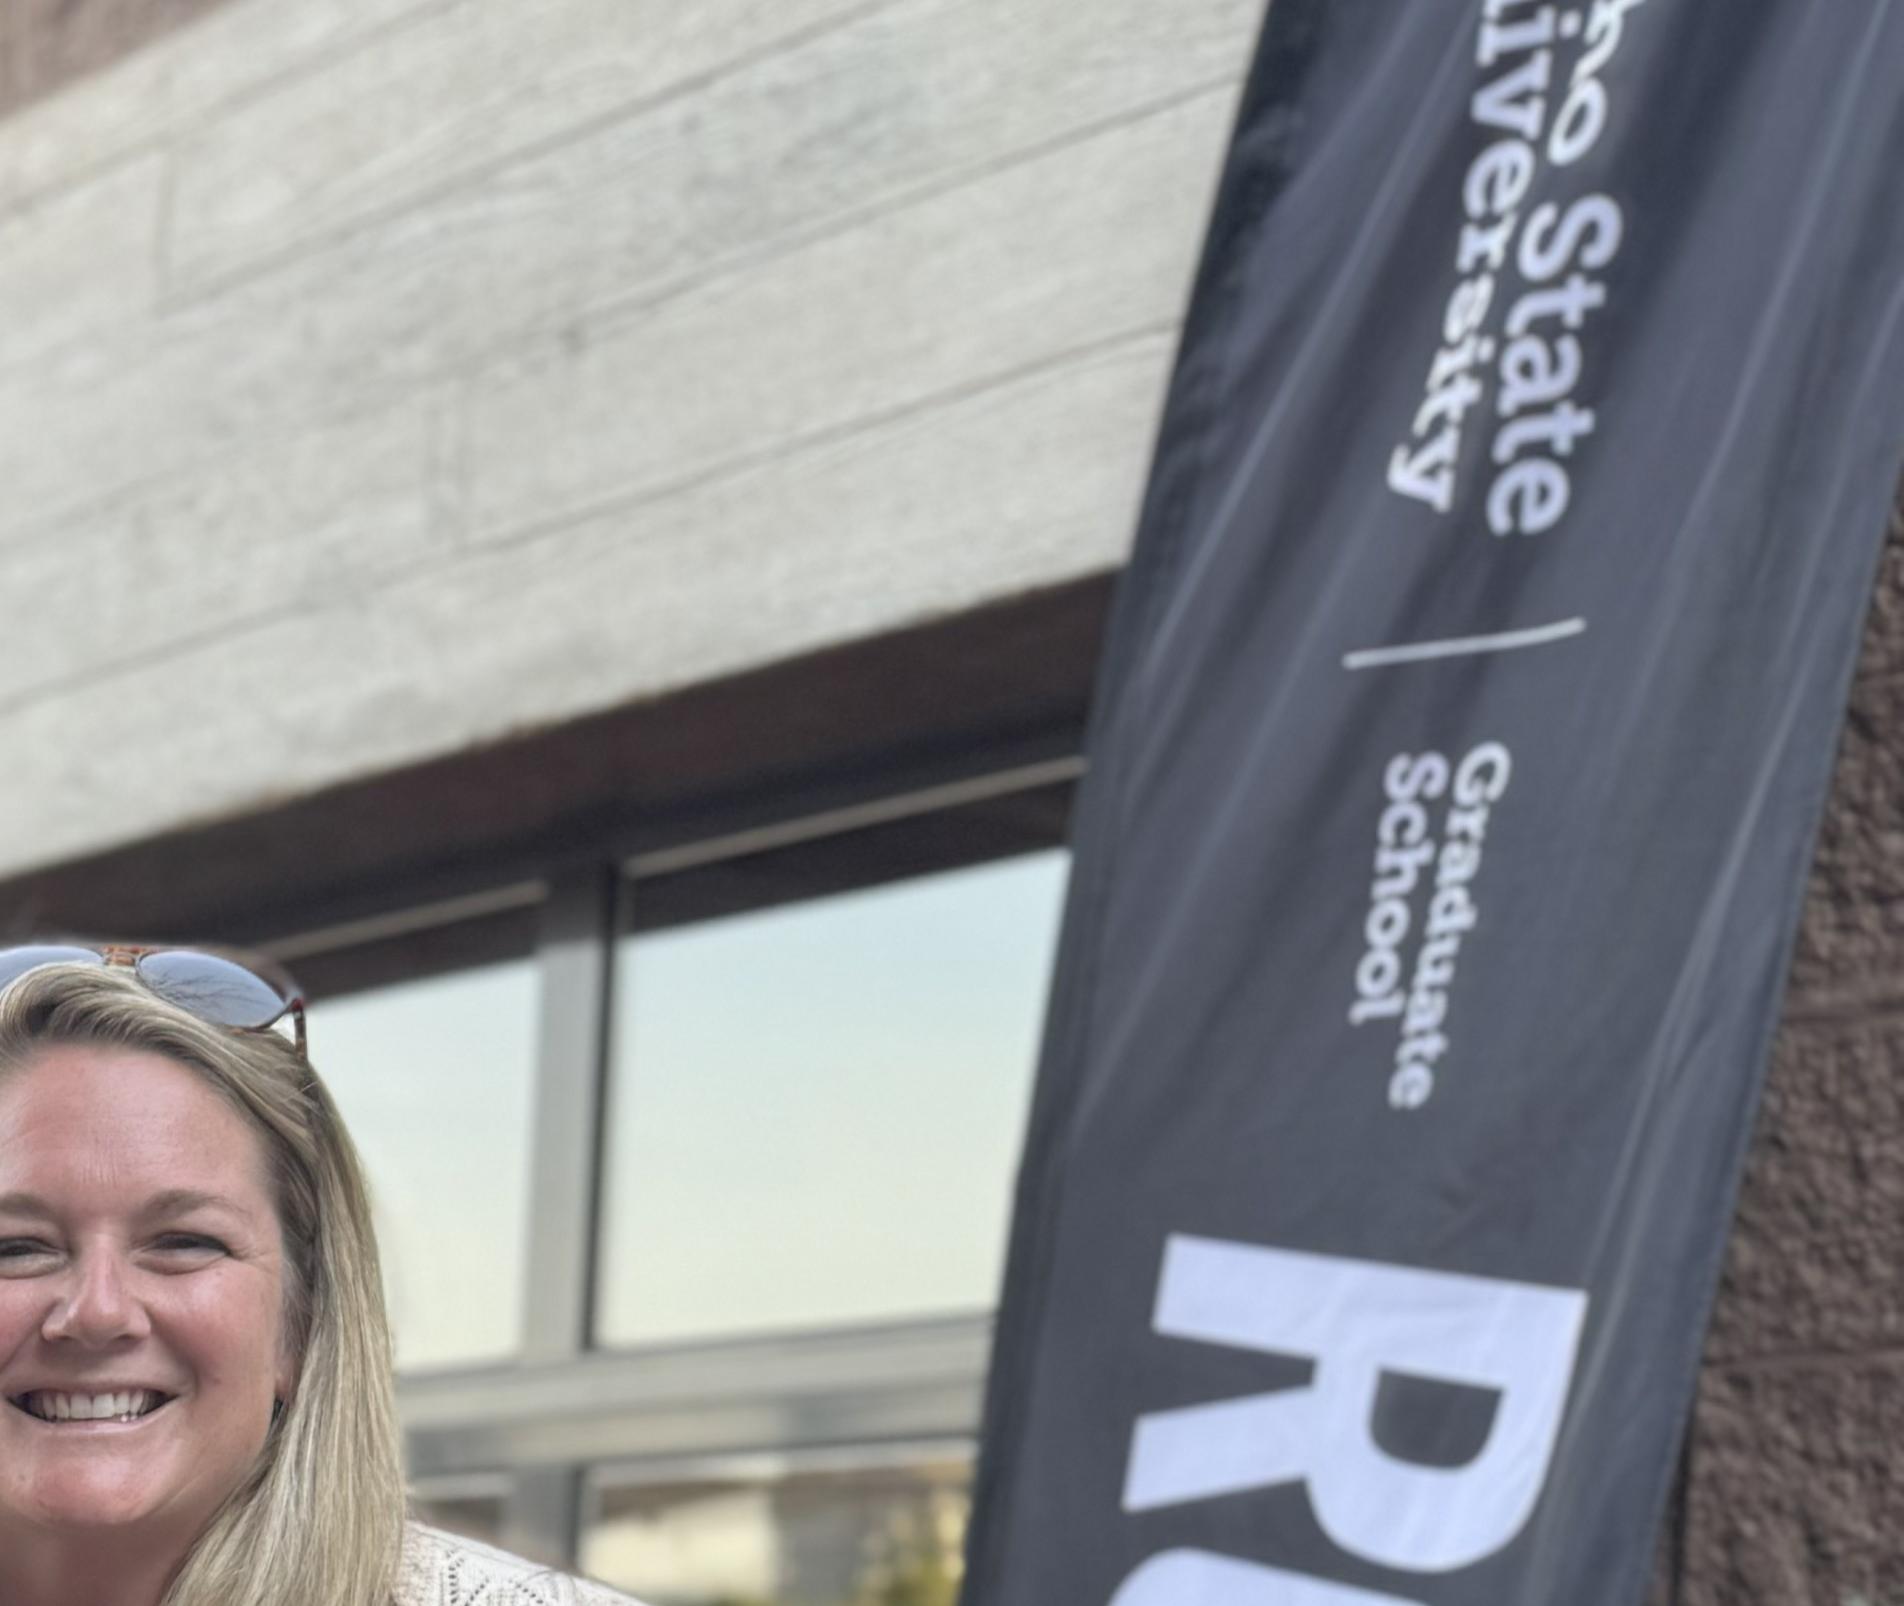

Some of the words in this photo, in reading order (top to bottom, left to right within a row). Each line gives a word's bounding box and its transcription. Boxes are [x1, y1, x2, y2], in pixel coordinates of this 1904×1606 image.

[1386, 0, 1580, 513] iversity
[1487, 195, 1622, 534] State
[1348, 752, 1450, 1025] School
[1387, 742, 1512, 1109] Graduate
